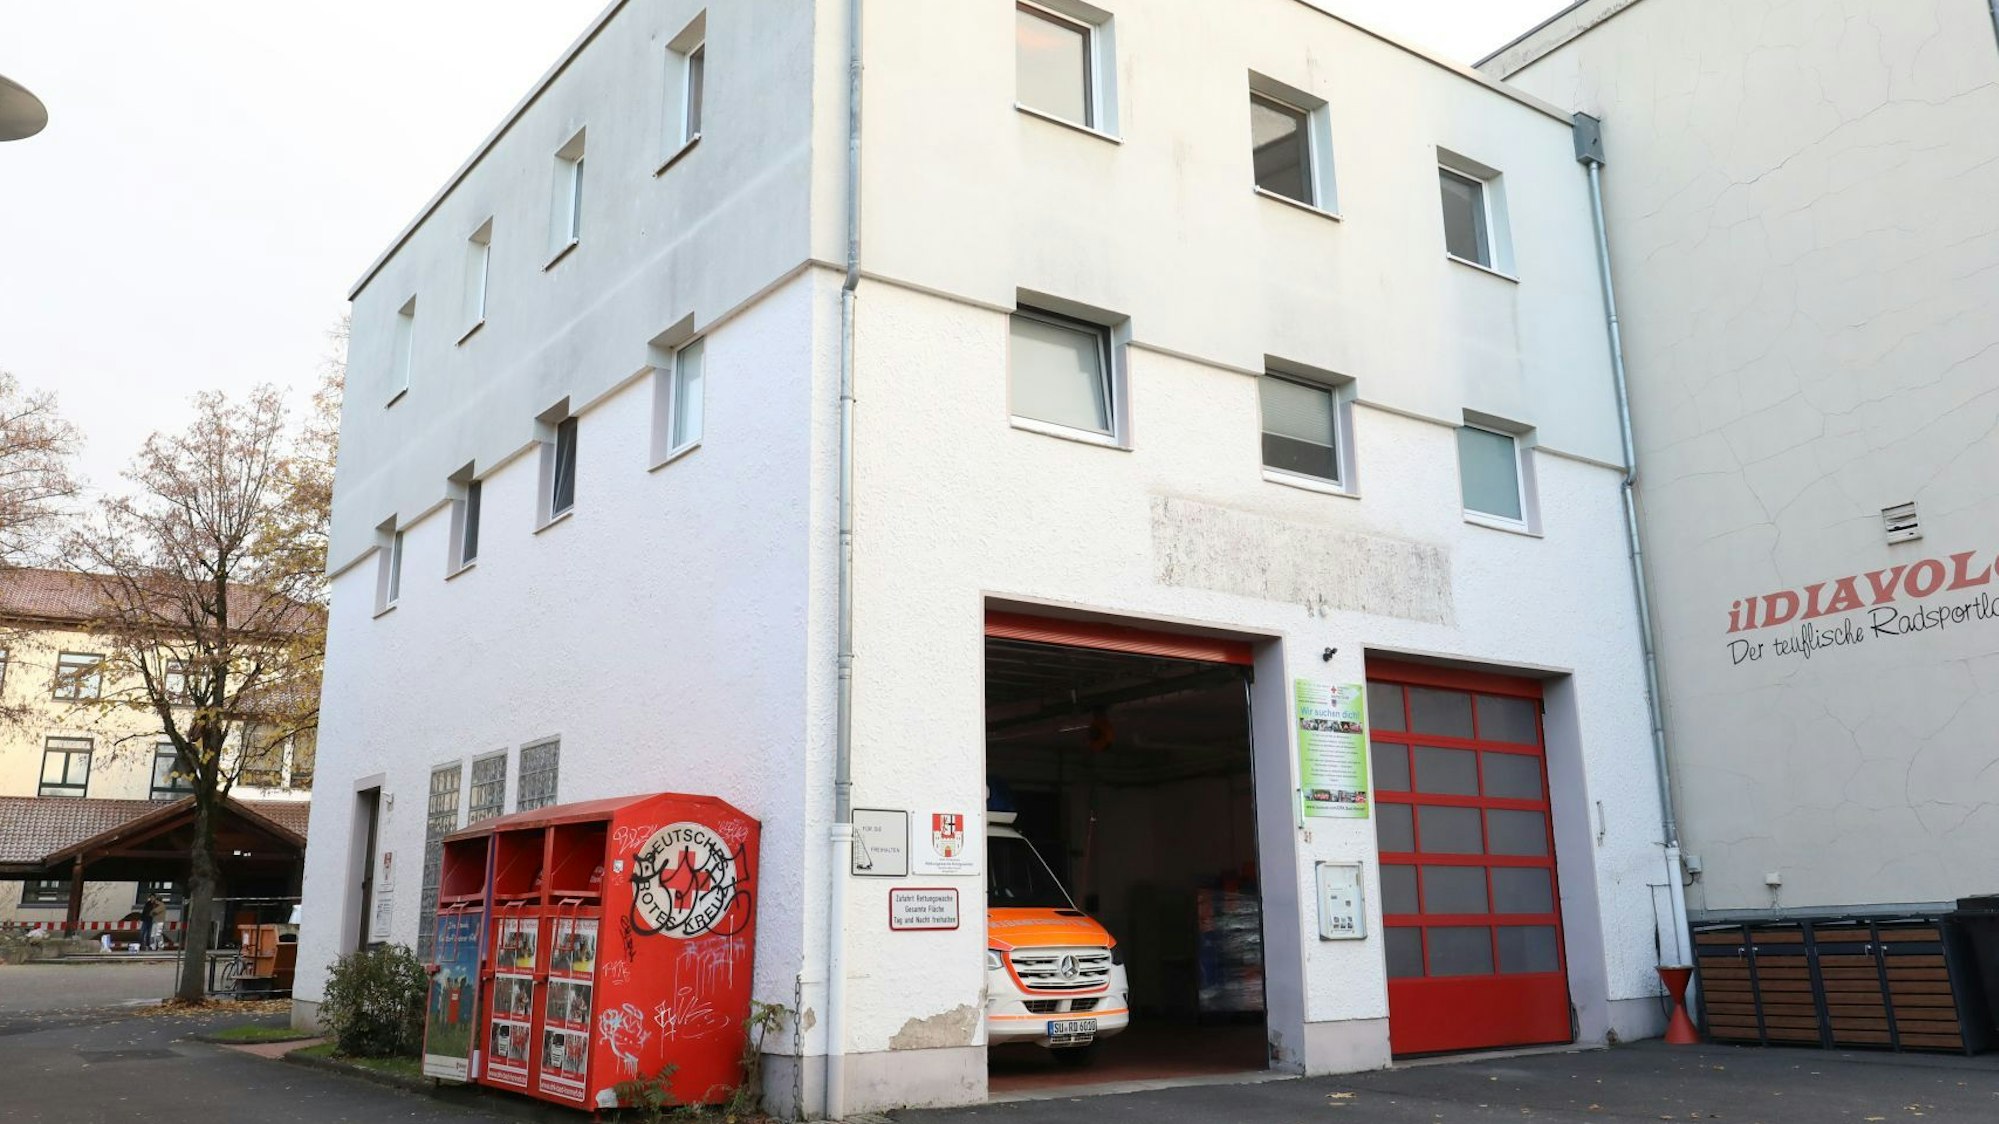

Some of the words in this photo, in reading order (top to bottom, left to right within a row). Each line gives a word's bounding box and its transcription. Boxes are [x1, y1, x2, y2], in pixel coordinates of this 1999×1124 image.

[1727, 639, 1764, 665] Der
[1774, 619, 1864, 660] teuflische
[1301, 706, 1313, 716] Wir
[1315, 709, 1340, 718] suchen
[1342, 711, 1360, 720] dich!
[639, 882, 677, 928] ROTES
[896, 894, 915, 902] Zufahrt
[917, 894, 953, 904] Rettungswache
[904, 905, 926, 913] Gesamte
[928, 905, 944, 913] Fläche
[894, 916, 902, 925] Tag
[905, 916, 914, 924] und
[916, 916, 930, 924] Nacht
[932, 916, 956, 924] freihalten
[1054, 1022, 1064, 1034] SU
[1068, 1021, 1078, 1031] RD
